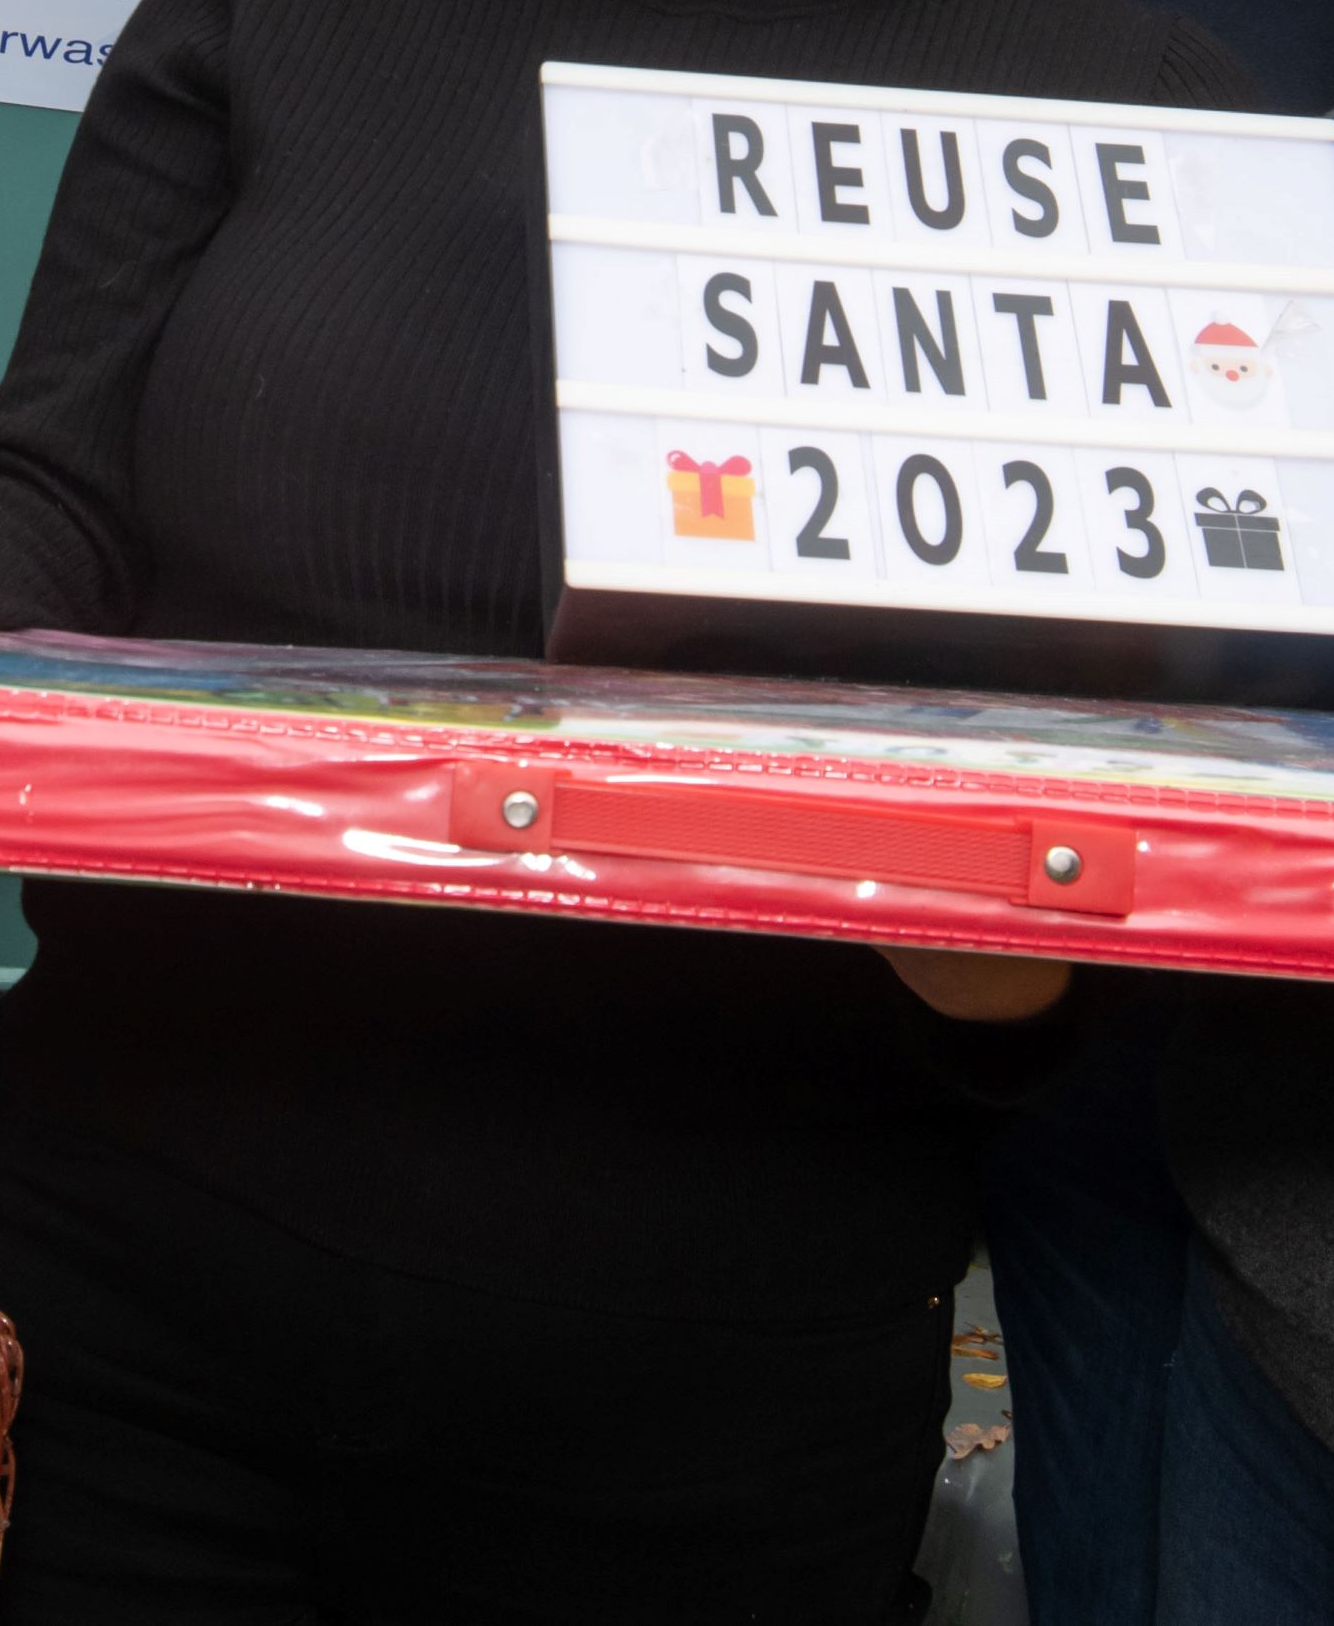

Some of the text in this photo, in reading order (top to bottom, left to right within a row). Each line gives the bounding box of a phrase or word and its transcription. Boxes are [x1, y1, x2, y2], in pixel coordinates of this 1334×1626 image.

[710, 111, 1162, 247] REUSE
[701, 271, 1173, 411] SANTA
[786, 444, 1167, 580] 2023
